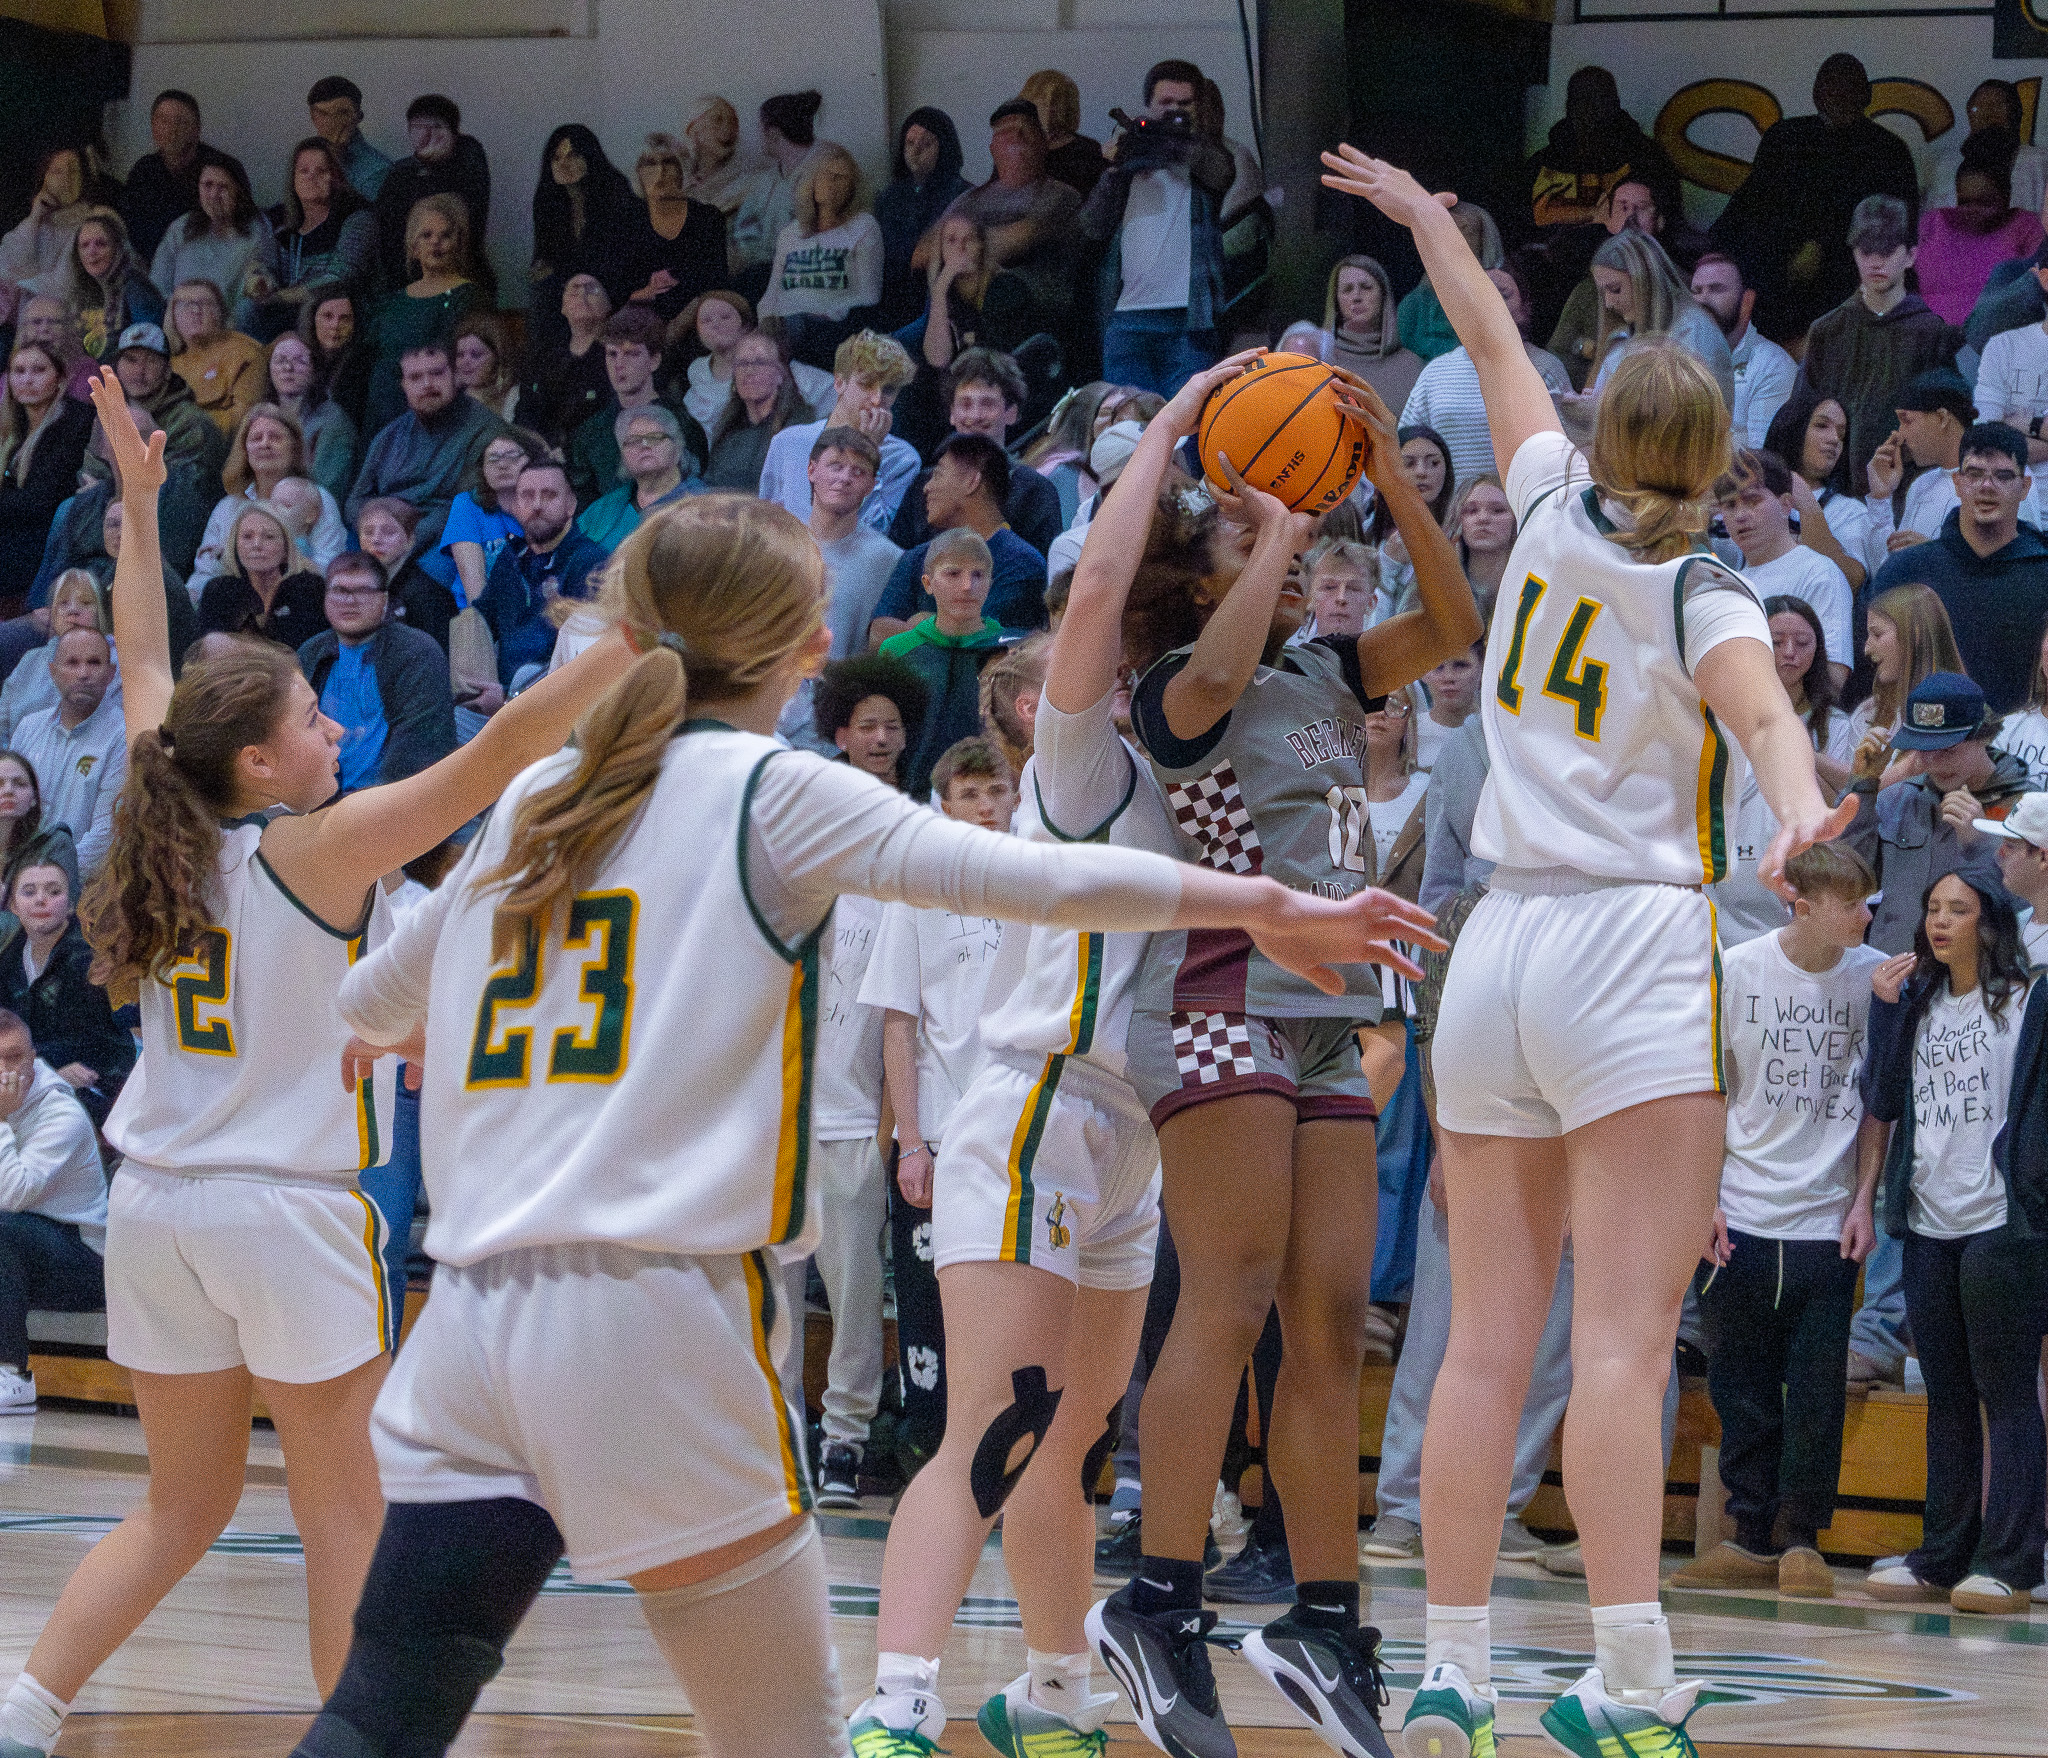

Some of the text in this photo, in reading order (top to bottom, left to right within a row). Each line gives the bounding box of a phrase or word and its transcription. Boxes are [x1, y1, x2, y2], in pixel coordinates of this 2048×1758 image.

[1496, 571, 1610, 743] 14
[172, 927, 238, 1058] 2
[464, 887, 641, 1093] 23
[1746, 995, 1850, 1028] I Would
[1761, 1028, 1864, 1060] NEVER
[1926, 1014, 1982, 1043] Would
[1914, 1030, 1991, 1076] NEVER
[1766, 1058, 1811, 1088] Get
[1944, 1066, 1991, 1097] Back
[1825, 1095, 1858, 1121] Ex
[1963, 1097, 1994, 1124] Ex
